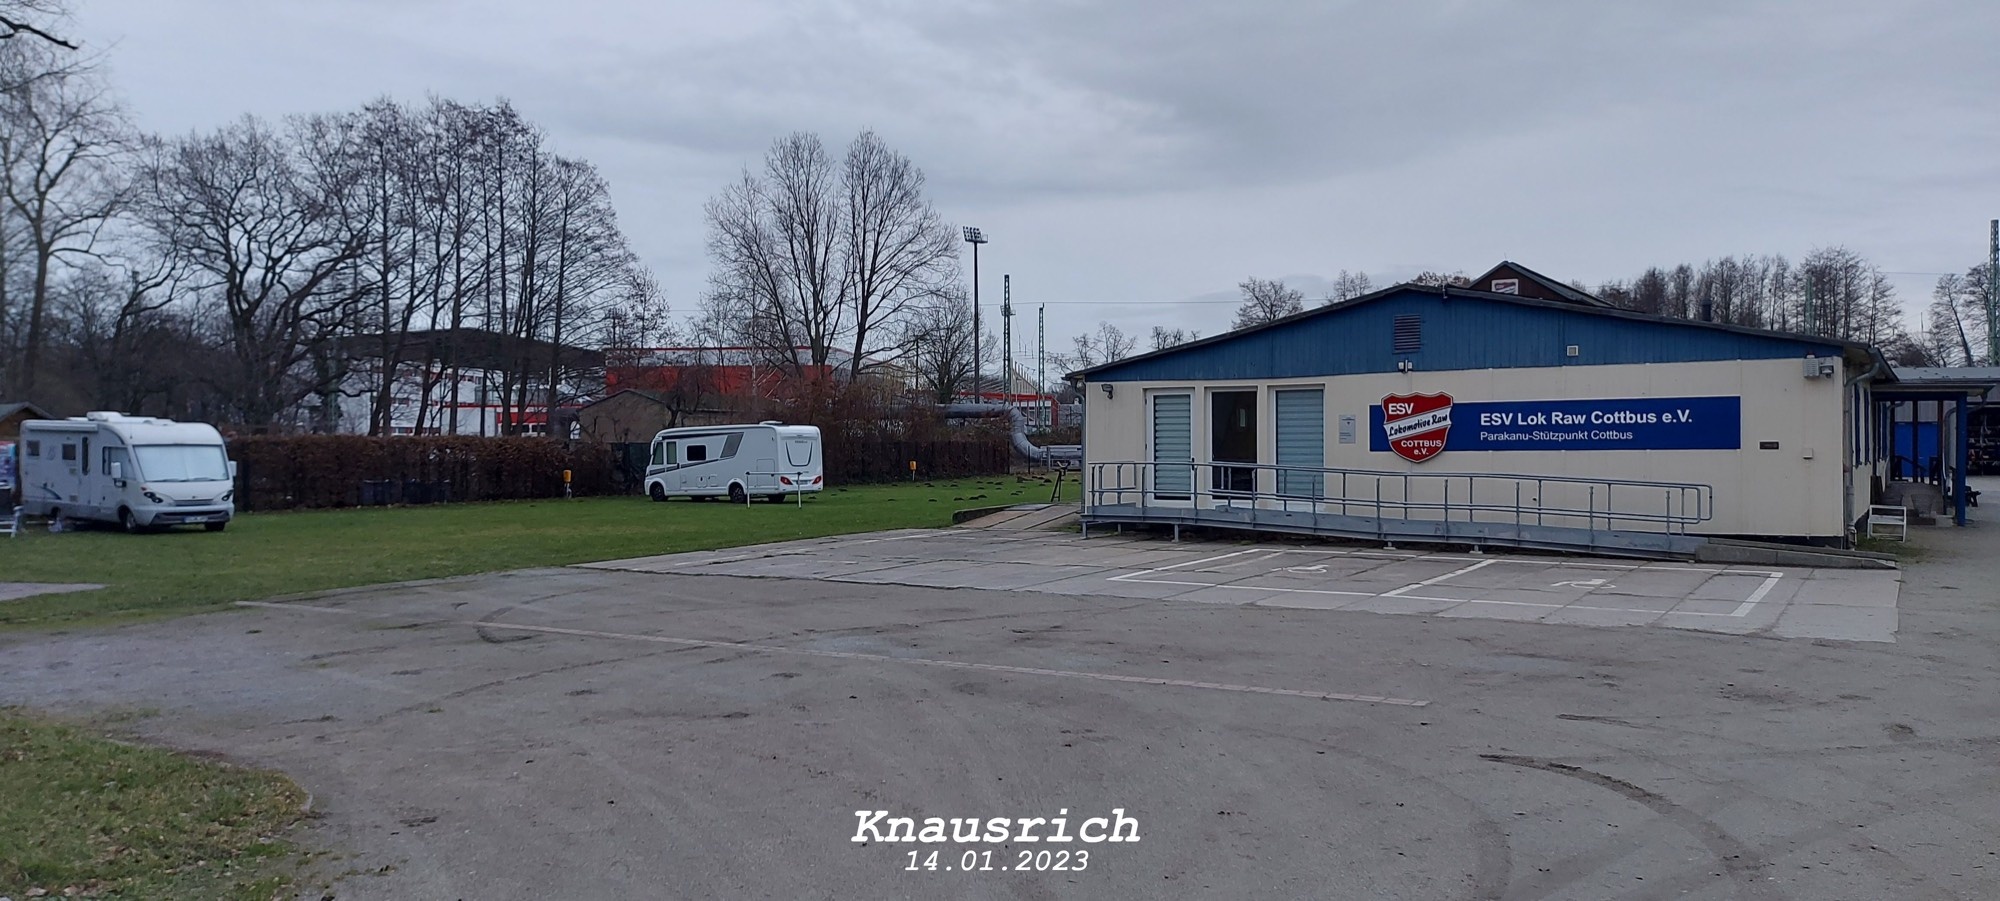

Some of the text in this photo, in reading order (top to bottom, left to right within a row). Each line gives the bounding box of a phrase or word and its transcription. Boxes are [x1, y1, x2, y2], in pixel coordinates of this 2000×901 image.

[1388, 402, 1414, 415] ESV
[1480, 409, 1693, 426] ESV Lok Raw Cottbus e.V.
[1388, 413, 1448, 437] Lokomotive Raw
[1480, 429, 1633, 442] Parakanu-Stützpunkt Cottbus
[1413, 447, 1429, 455] e.V.
